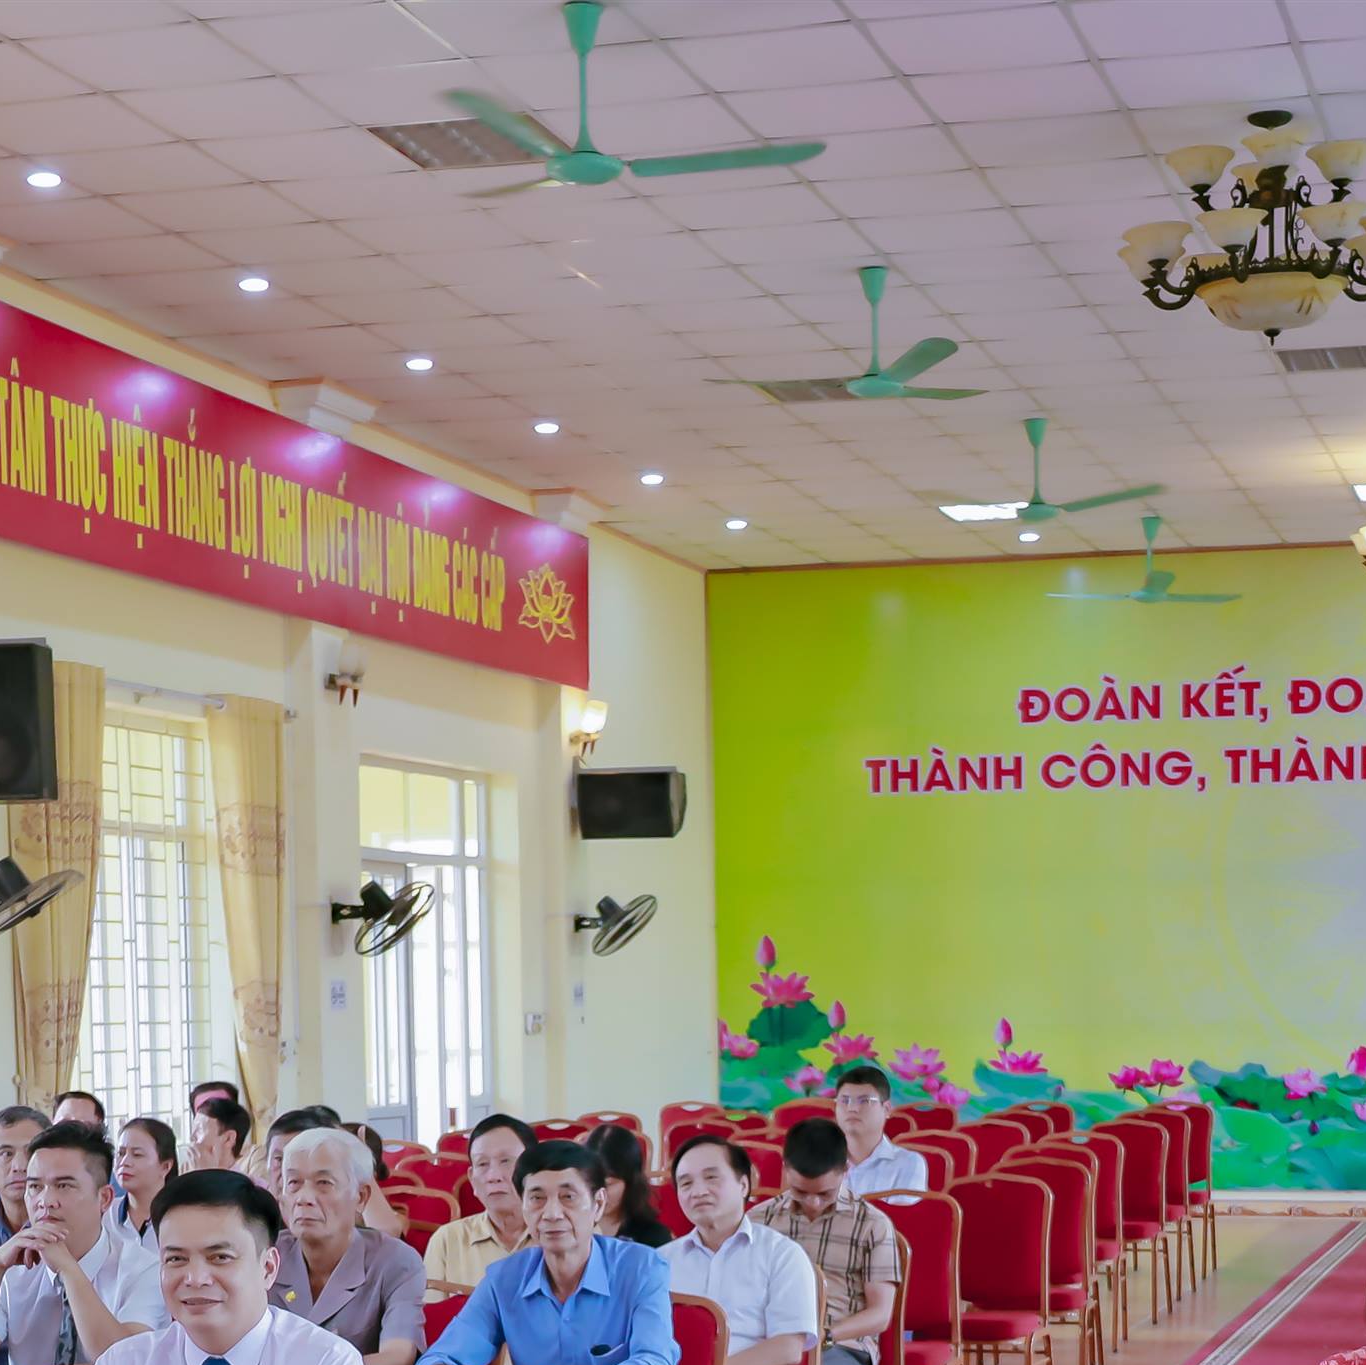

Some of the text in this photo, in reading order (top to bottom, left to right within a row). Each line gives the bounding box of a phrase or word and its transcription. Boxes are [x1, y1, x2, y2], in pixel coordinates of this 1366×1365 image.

[50, 398, 108, 534] THỰC
[111, 404, 160, 549] HIỆN
[163, 408, 226, 550] THẮNG
[229, 456, 258, 579] LỢI
[261, 471, 303, 594] NGHỊ
[306, 472, 355, 588] QUYẾT
[358, 506, 383, 615] ĐẠI
[386, 502, 411, 622] HỘI
[452, 527, 478, 625] CÁC
[1017, 674, 1162, 724] ĐOÀN
[1180, 664, 1269, 723] KẾT,
[864, 746, 1023, 794] THÀNH
[1040, 742, 1207, 792] CÔNG,
